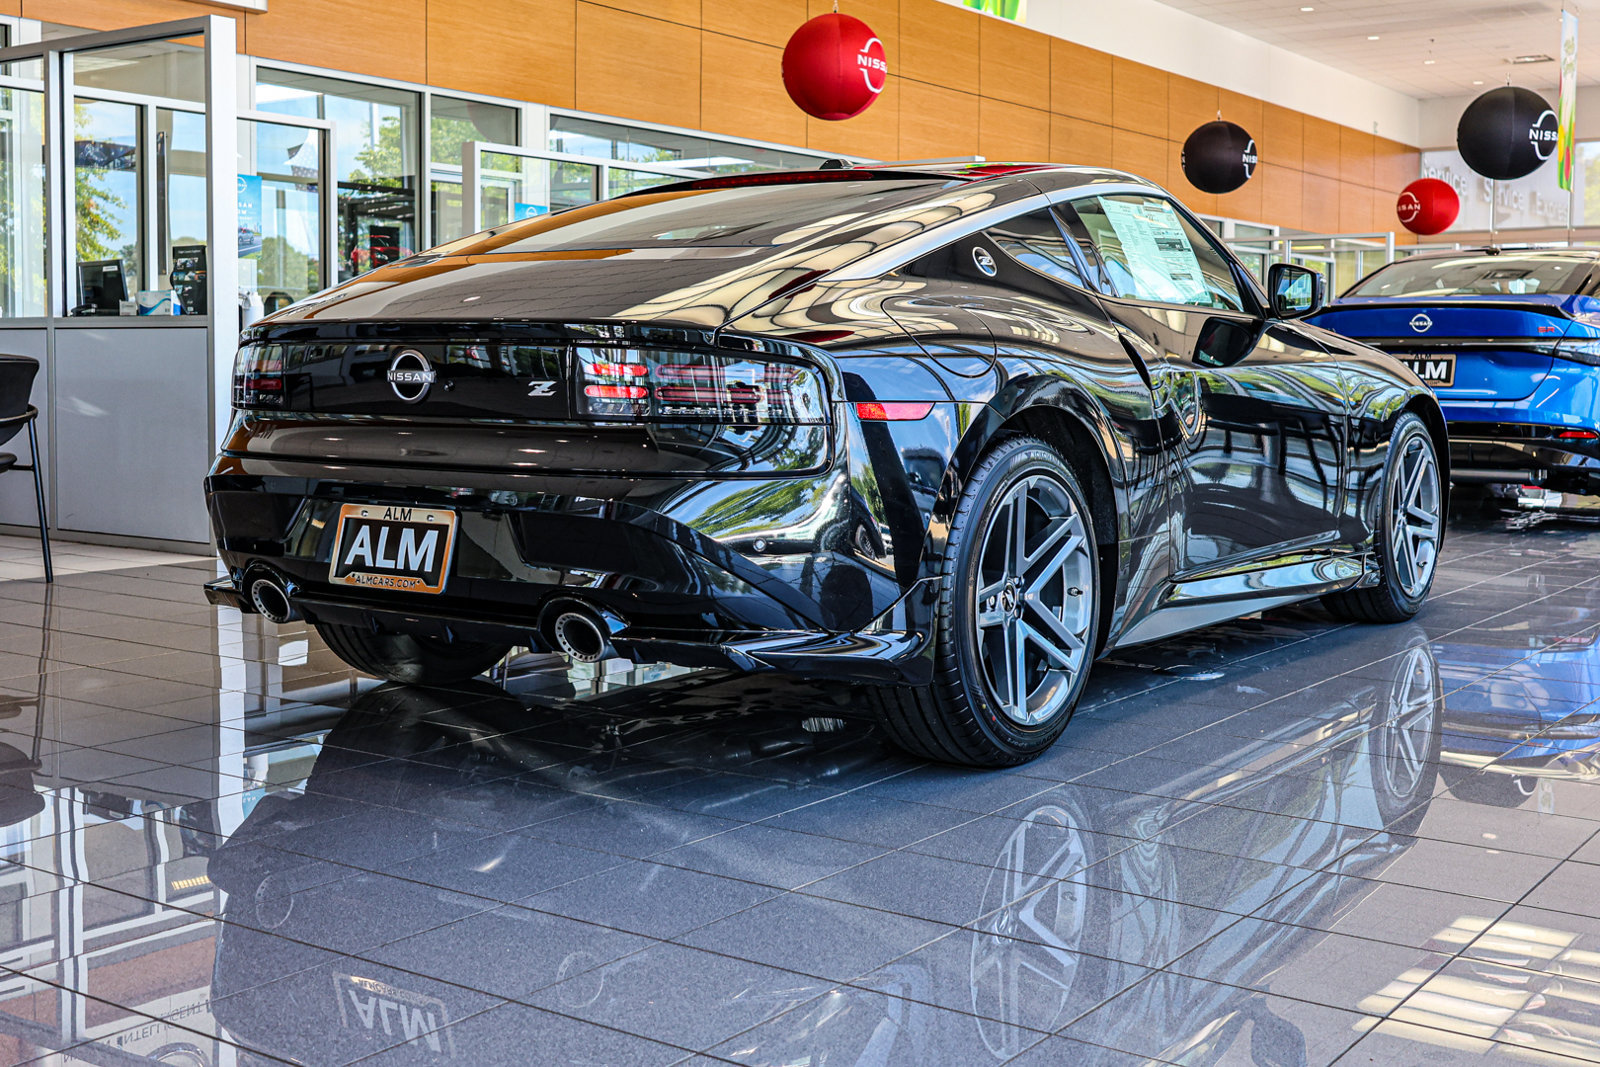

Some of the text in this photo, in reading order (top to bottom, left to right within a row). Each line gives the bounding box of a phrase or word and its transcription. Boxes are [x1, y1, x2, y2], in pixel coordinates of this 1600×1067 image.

[857, 54, 888, 74] NISS
[387, 371, 433, 382] NISSAN
[528, 380, 557, 397] Z
[383, 506, 412, 522] ALM
[344, 524, 439, 573] ALM
[355, 575, 416, 589] ALMCARS.COM
